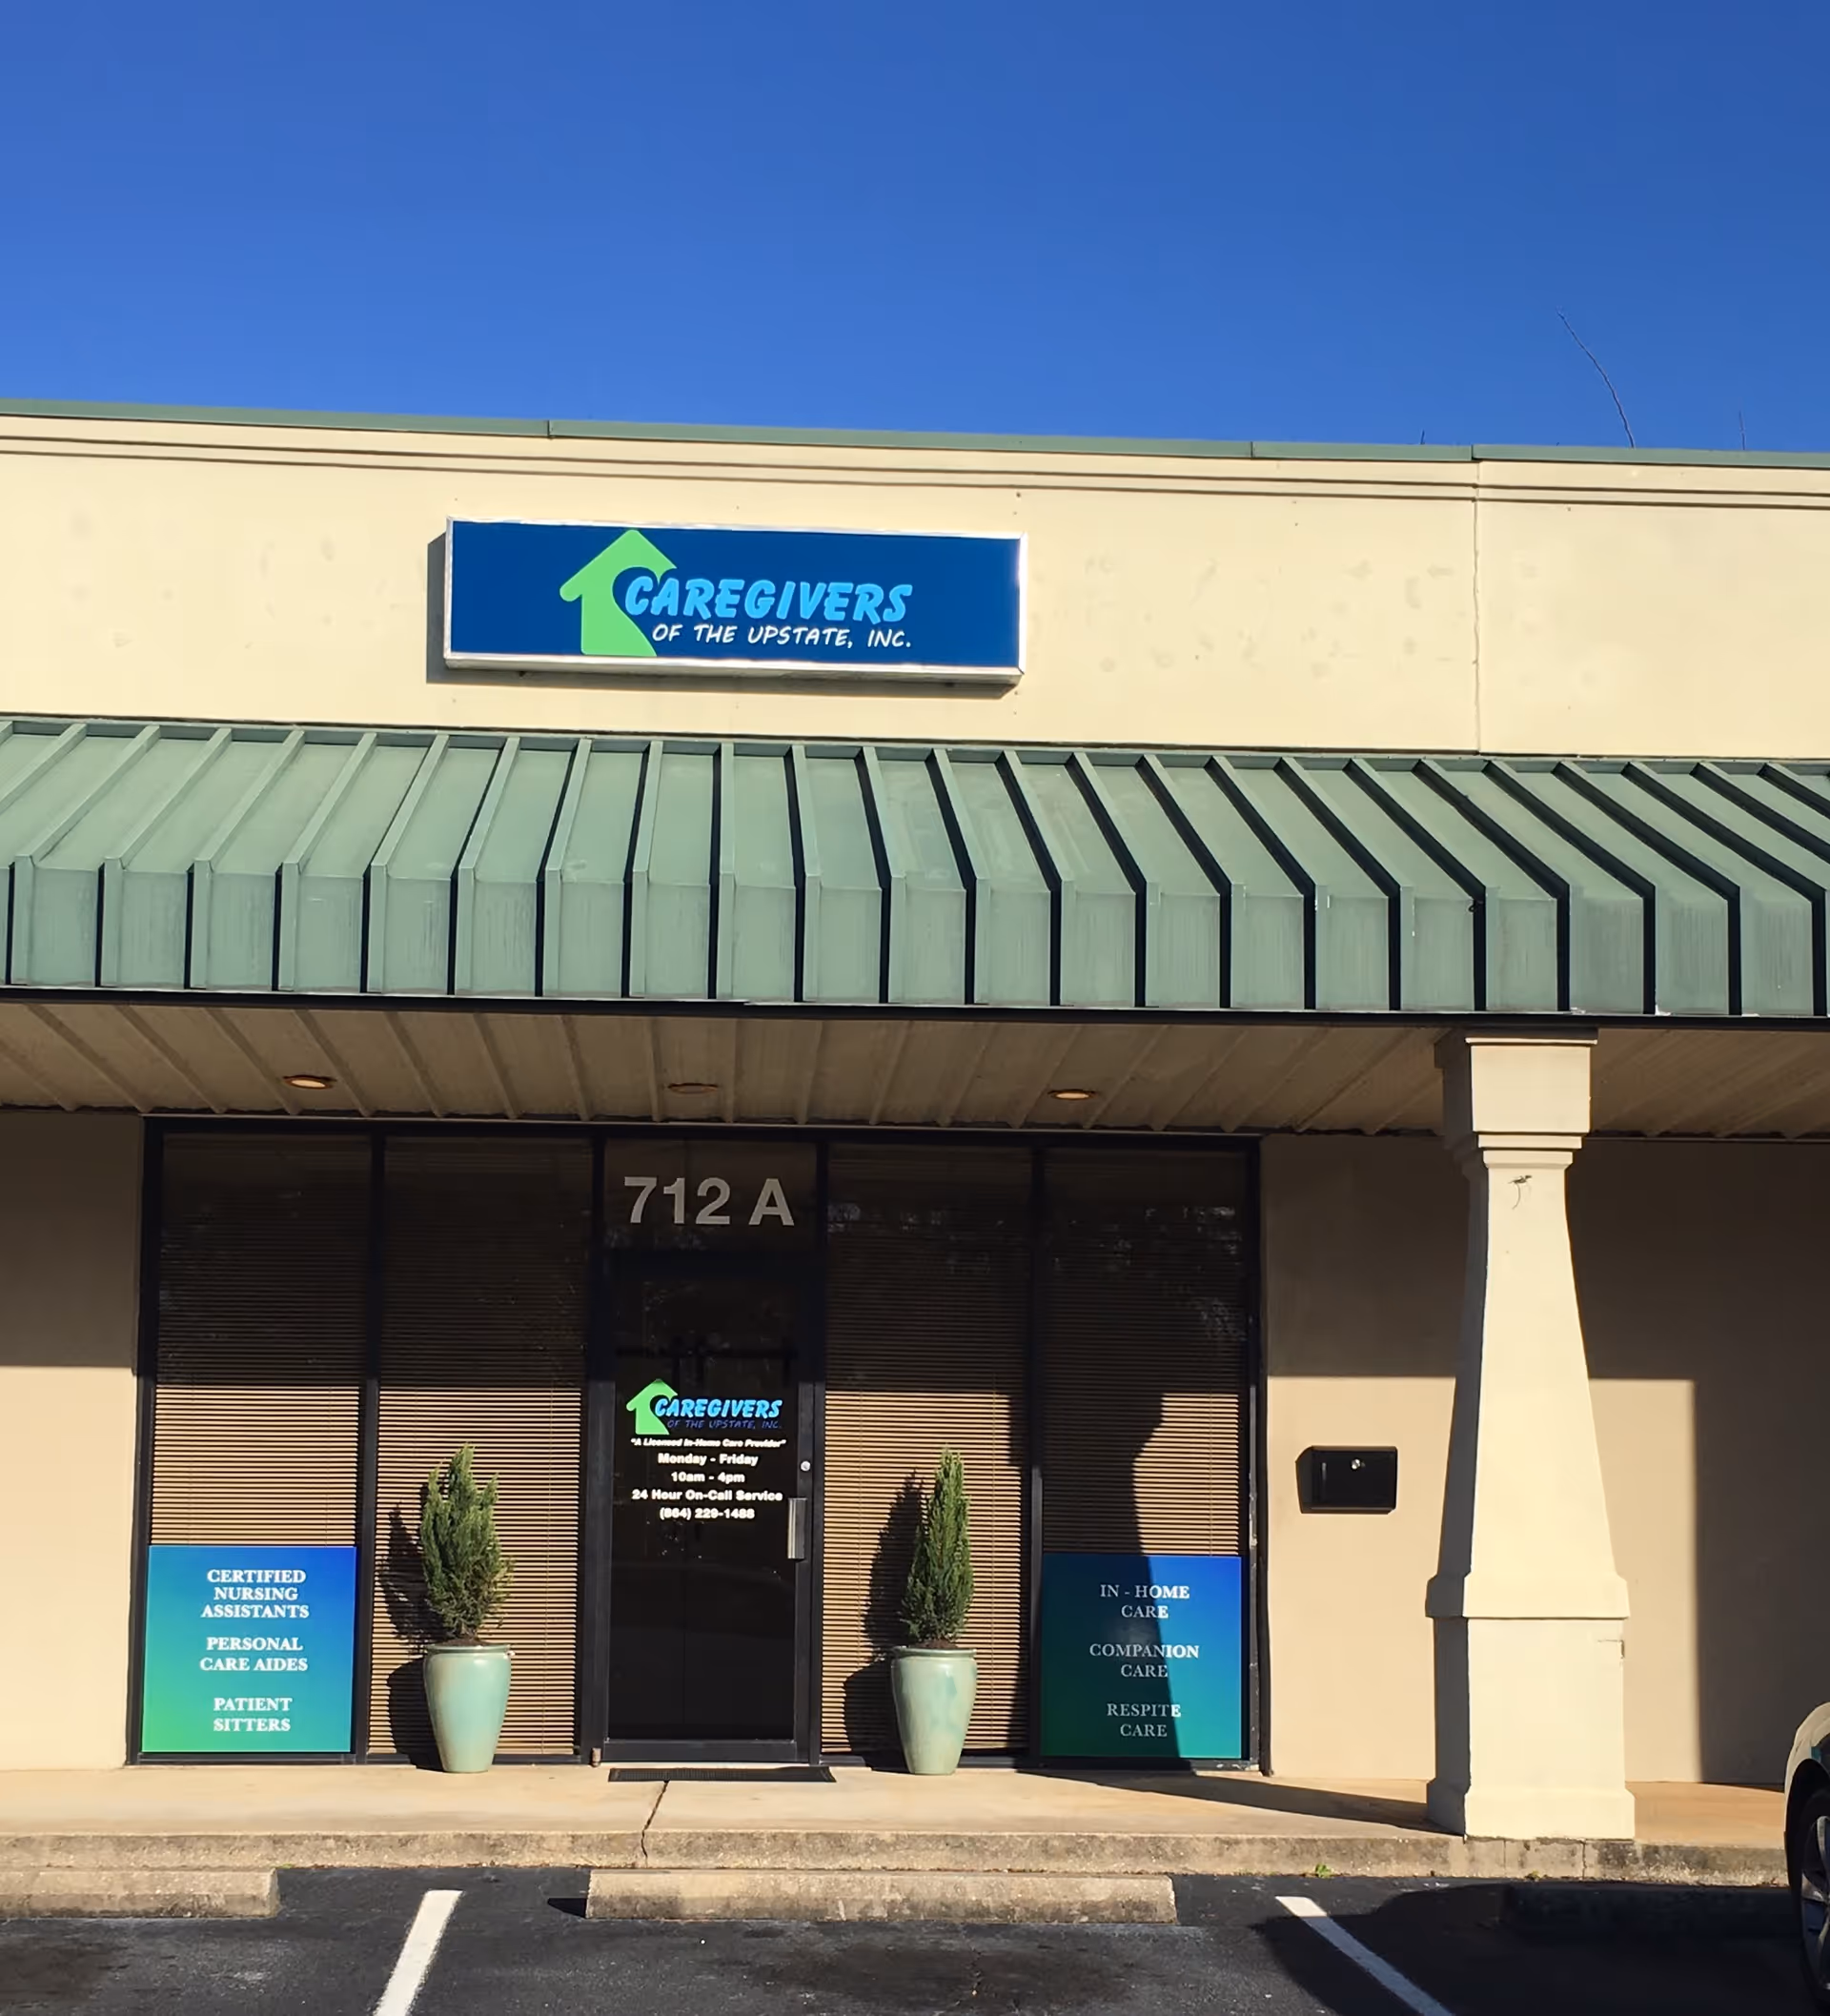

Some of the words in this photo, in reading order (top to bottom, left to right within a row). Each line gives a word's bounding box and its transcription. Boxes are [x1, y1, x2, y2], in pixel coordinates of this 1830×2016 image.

[624, 576, 913, 624] CAREGIVERS
[652, 623, 683, 641] OF
[693, 624, 738, 642] THE
[747, 625, 854, 648] UPSTATE,
[867, 629, 912, 647] INC.
[624, 1176, 730, 1225] 712
[748, 1178, 795, 1226] A
[655, 1397, 783, 1418] CAREGIVERS
[667, 1419, 681, 1429] OF
[685, 1419, 705, 1429] THE
[708, 1419, 756, 1430] UPSTATE,
[762, 1420, 782, 1430] INC.
[643, 1437, 682, 1447] Licensed
[722, 1438, 743, 1448] Care
[658, 1453, 707, 1466] Monday
[720, 1454, 759, 1467] Friday
[671, 1471, 705, 1482] 10am
[718, 1472, 745, 1484] 4pm
[632, 1489, 648, 1500] 24
[652, 1489, 682, 1500] Hour
[685, 1489, 733, 1501] On-Call
[736, 1490, 783, 1501] Service
[207, 1569, 307, 1583] CERTIFIED
[214, 1587, 298, 1601] NURSING
[1100, 1584, 1120, 1598] IN
[1134, 1585, 1190, 1599] HOME
[200, 1604, 310, 1619] ASSISTANTS
[1121, 1604, 1169, 1619] CARE
[206, 1637, 303, 1651] PERSONAL
[1089, 1643, 1200, 1659] COMPANION
[199, 1657, 251, 1671] CARE
[253, 1658, 308, 1672] AIDES
[1120, 1664, 1169, 1678] CARE
[214, 1697, 293, 1711] PATIENT
[1107, 1702, 1182, 1718] RESPITE
[214, 1718, 291, 1732] SITTERS
[1120, 1723, 1168, 1738] CARE
